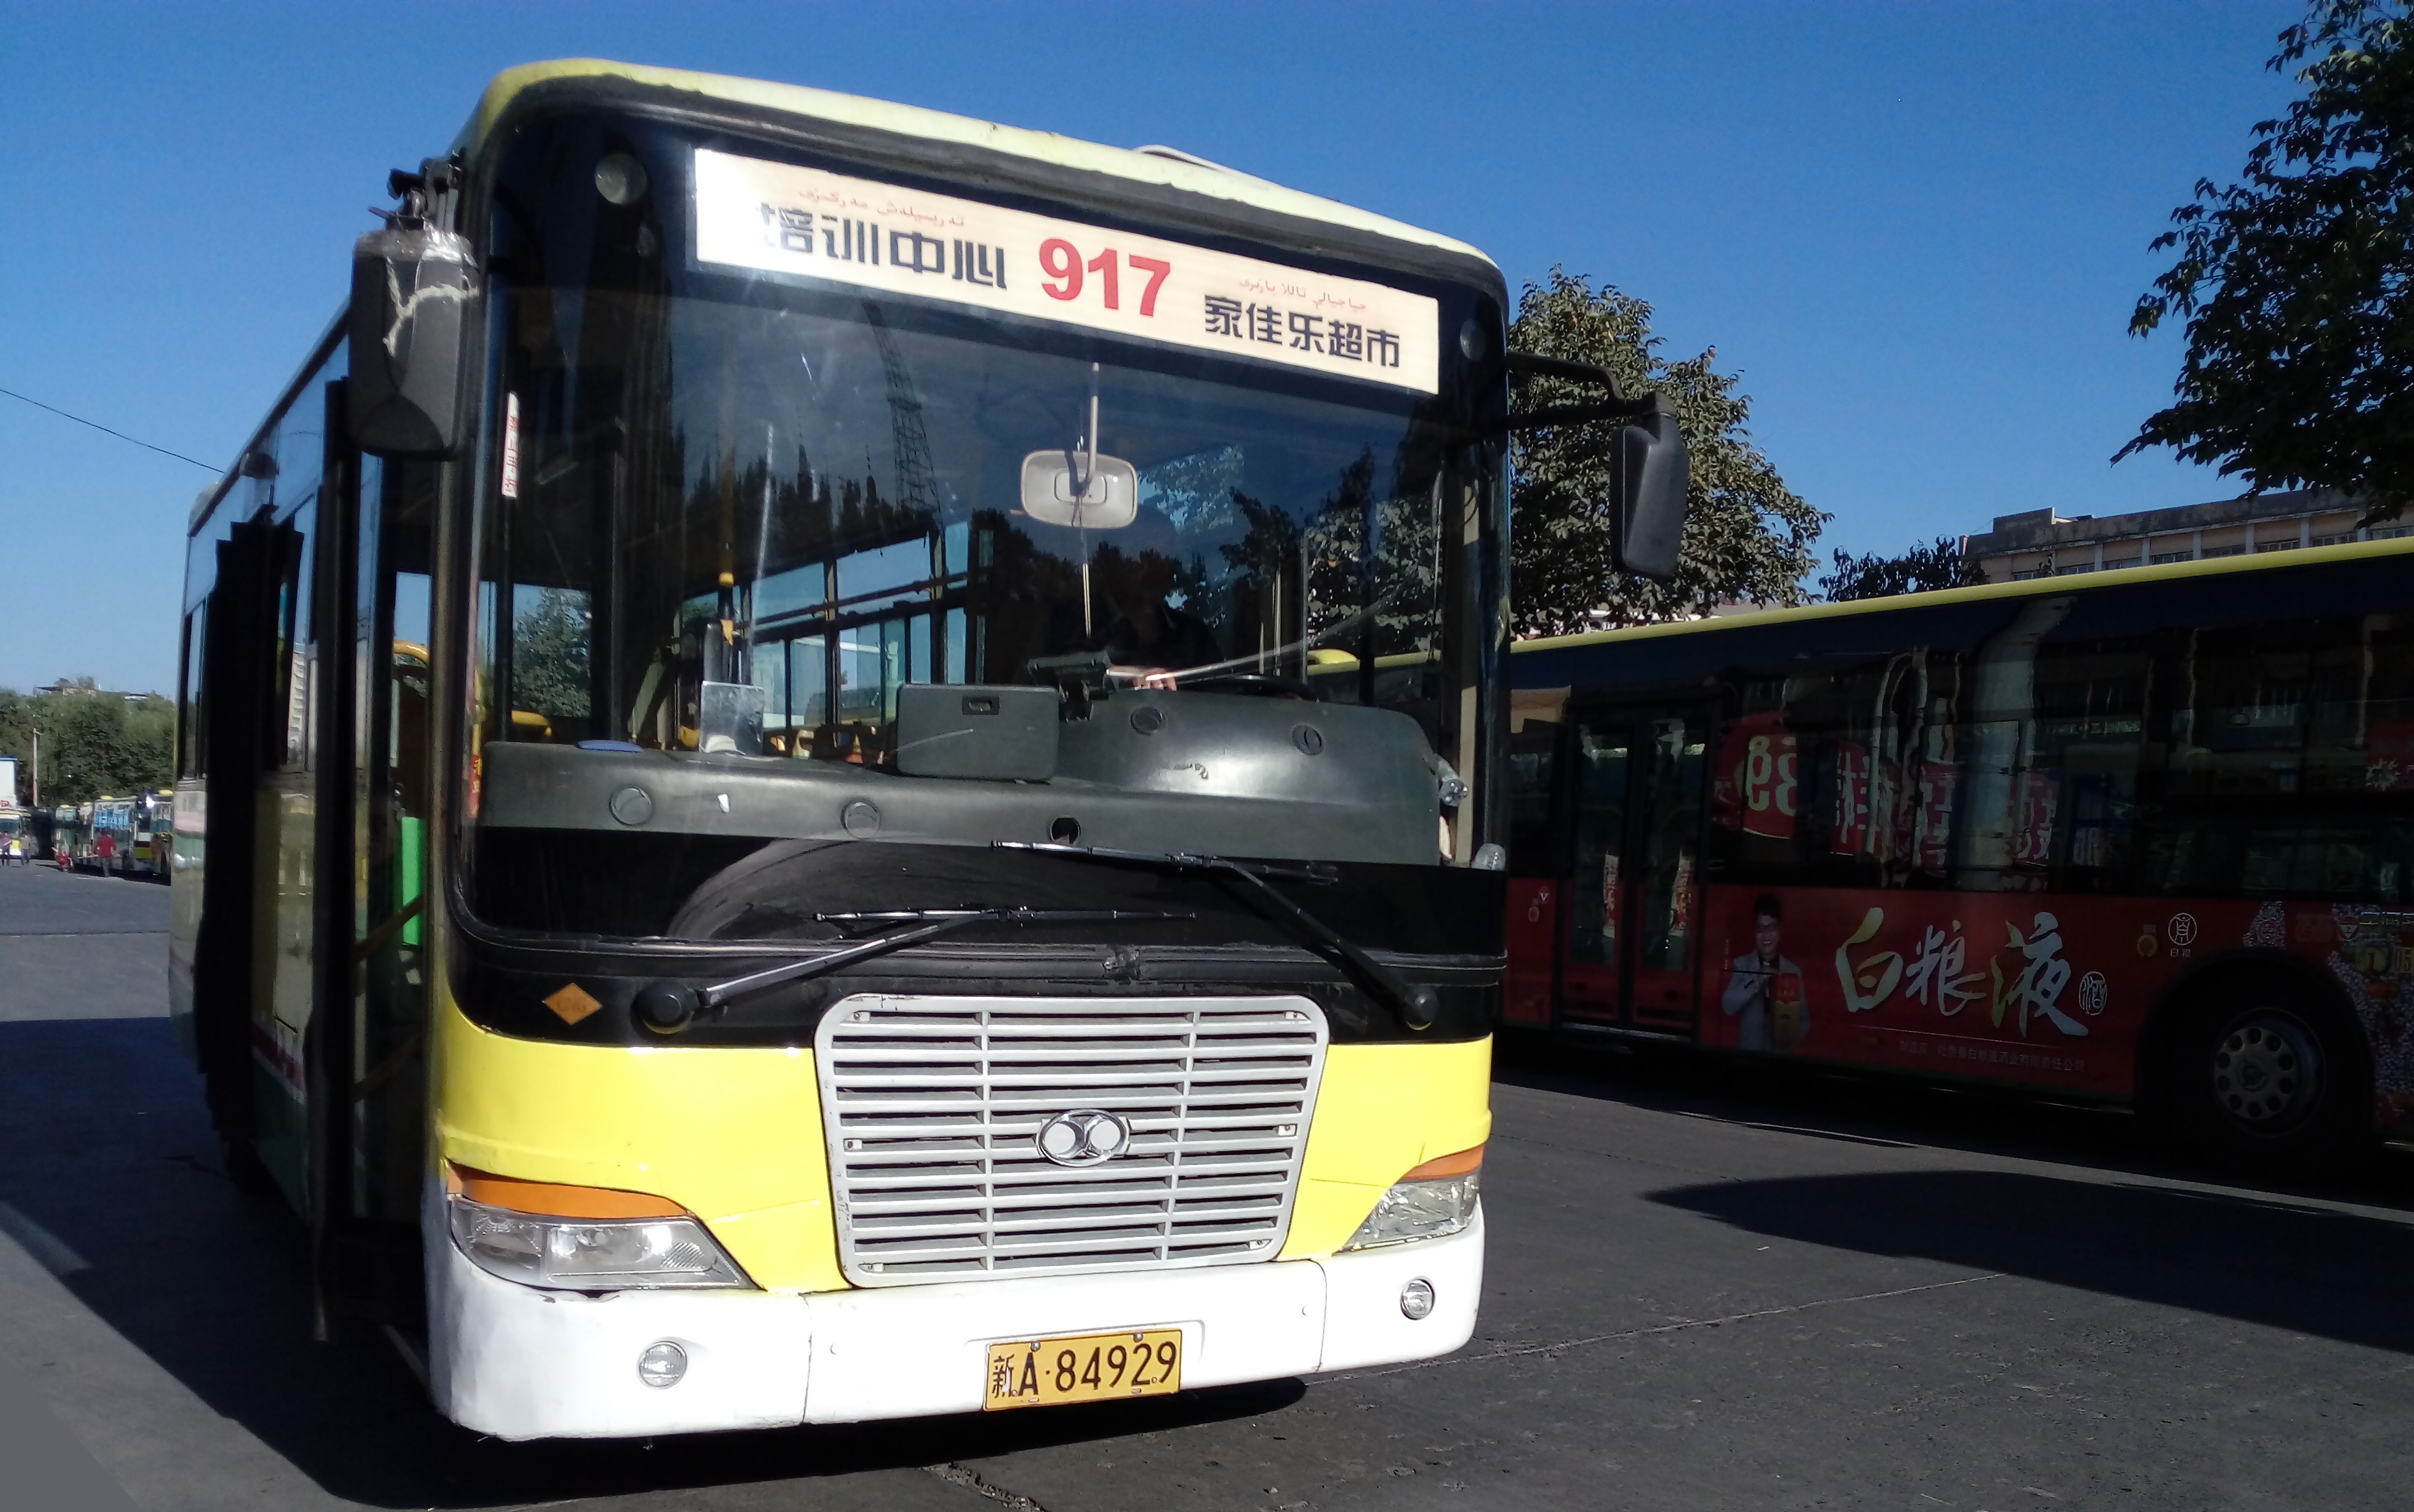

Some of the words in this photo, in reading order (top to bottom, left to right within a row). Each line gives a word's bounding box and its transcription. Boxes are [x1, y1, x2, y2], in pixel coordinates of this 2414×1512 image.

[758, 202, 1007, 289] 培训中心
[1040, 238, 1171, 317] 917
[1205, 294, 1399, 368] 家佳乐超市
[1835, 906, 2088, 1037] 白粮液
